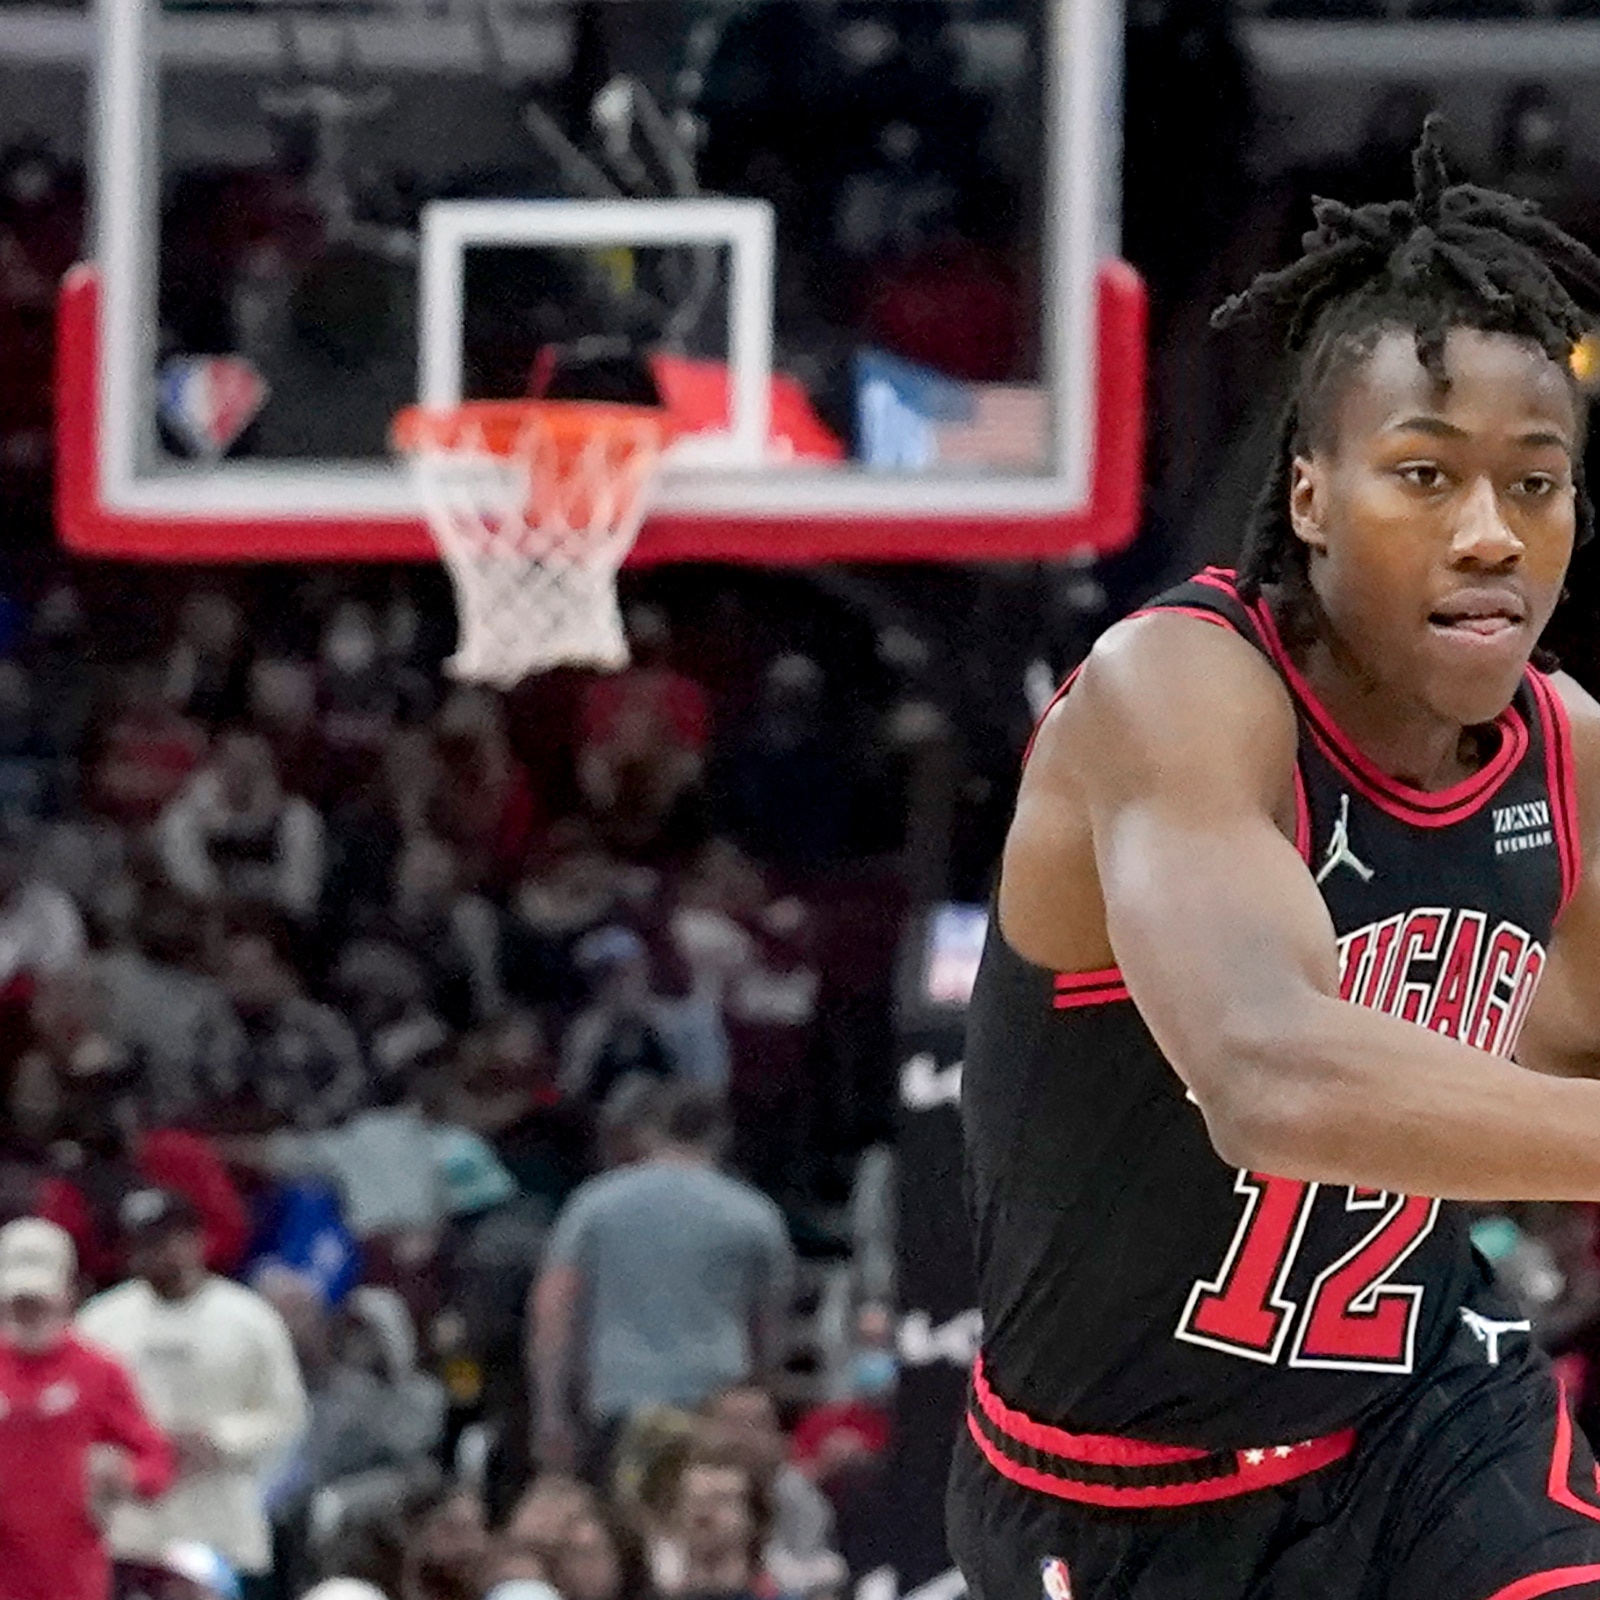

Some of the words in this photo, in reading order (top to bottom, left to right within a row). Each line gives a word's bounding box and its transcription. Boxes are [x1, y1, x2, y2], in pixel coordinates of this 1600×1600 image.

[1492, 799, 1550, 834] ZENNI
[1494, 829, 1554, 856] EYEWEAR
[1334, 906, 1548, 1064] ICAGO
[1173, 1167, 1442, 1375] 12
